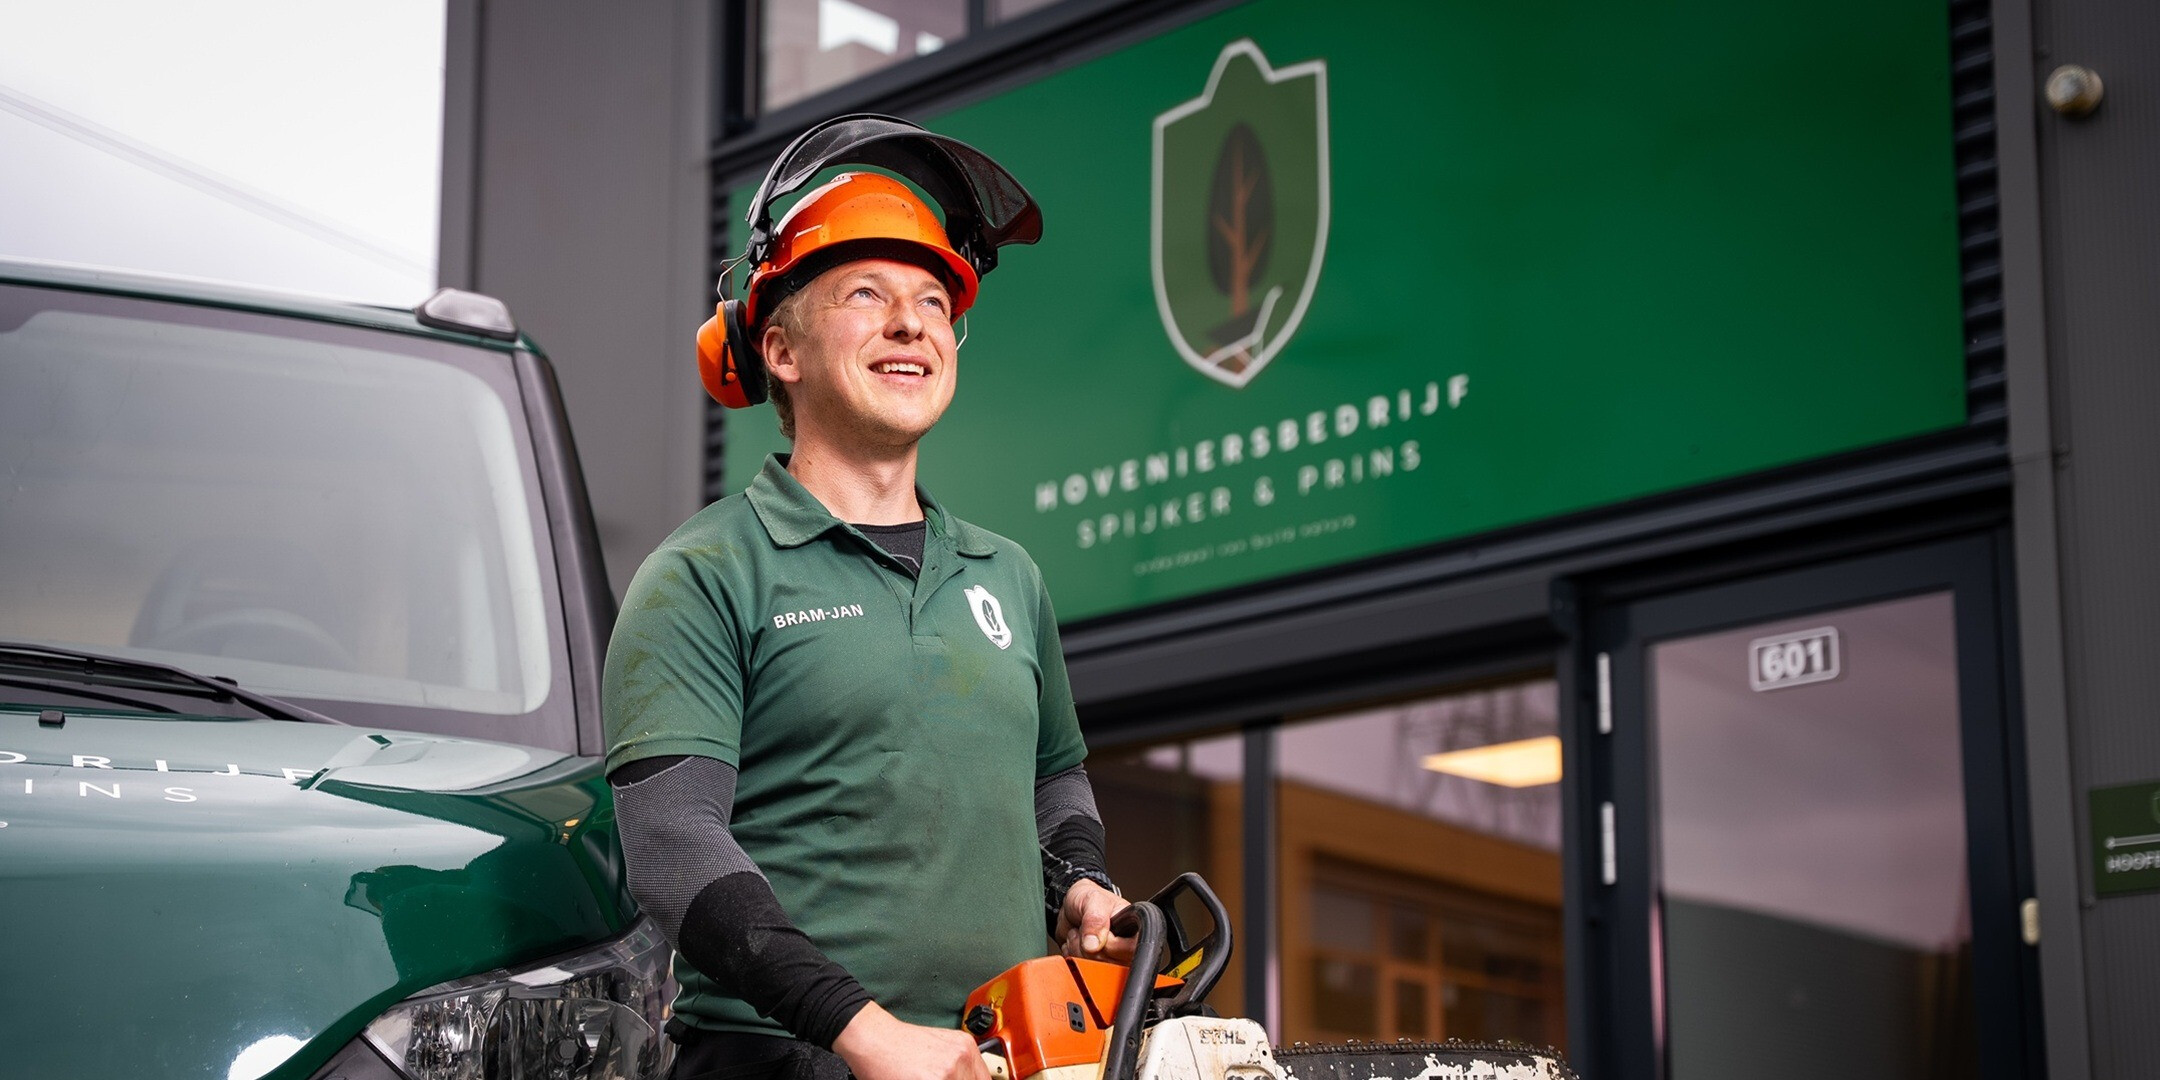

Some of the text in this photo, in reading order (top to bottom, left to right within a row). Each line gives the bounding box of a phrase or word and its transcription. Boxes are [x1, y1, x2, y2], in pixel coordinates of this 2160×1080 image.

[1035, 373, 1469, 513] HOVENIERSBEDRIJF
[1076, 440, 1421, 549] SPIJKER & PRINS
[773, 604, 864, 629] BRAM-JAN
[1761, 637, 1824, 682] 601
[25, 778, 198, 802] INS
